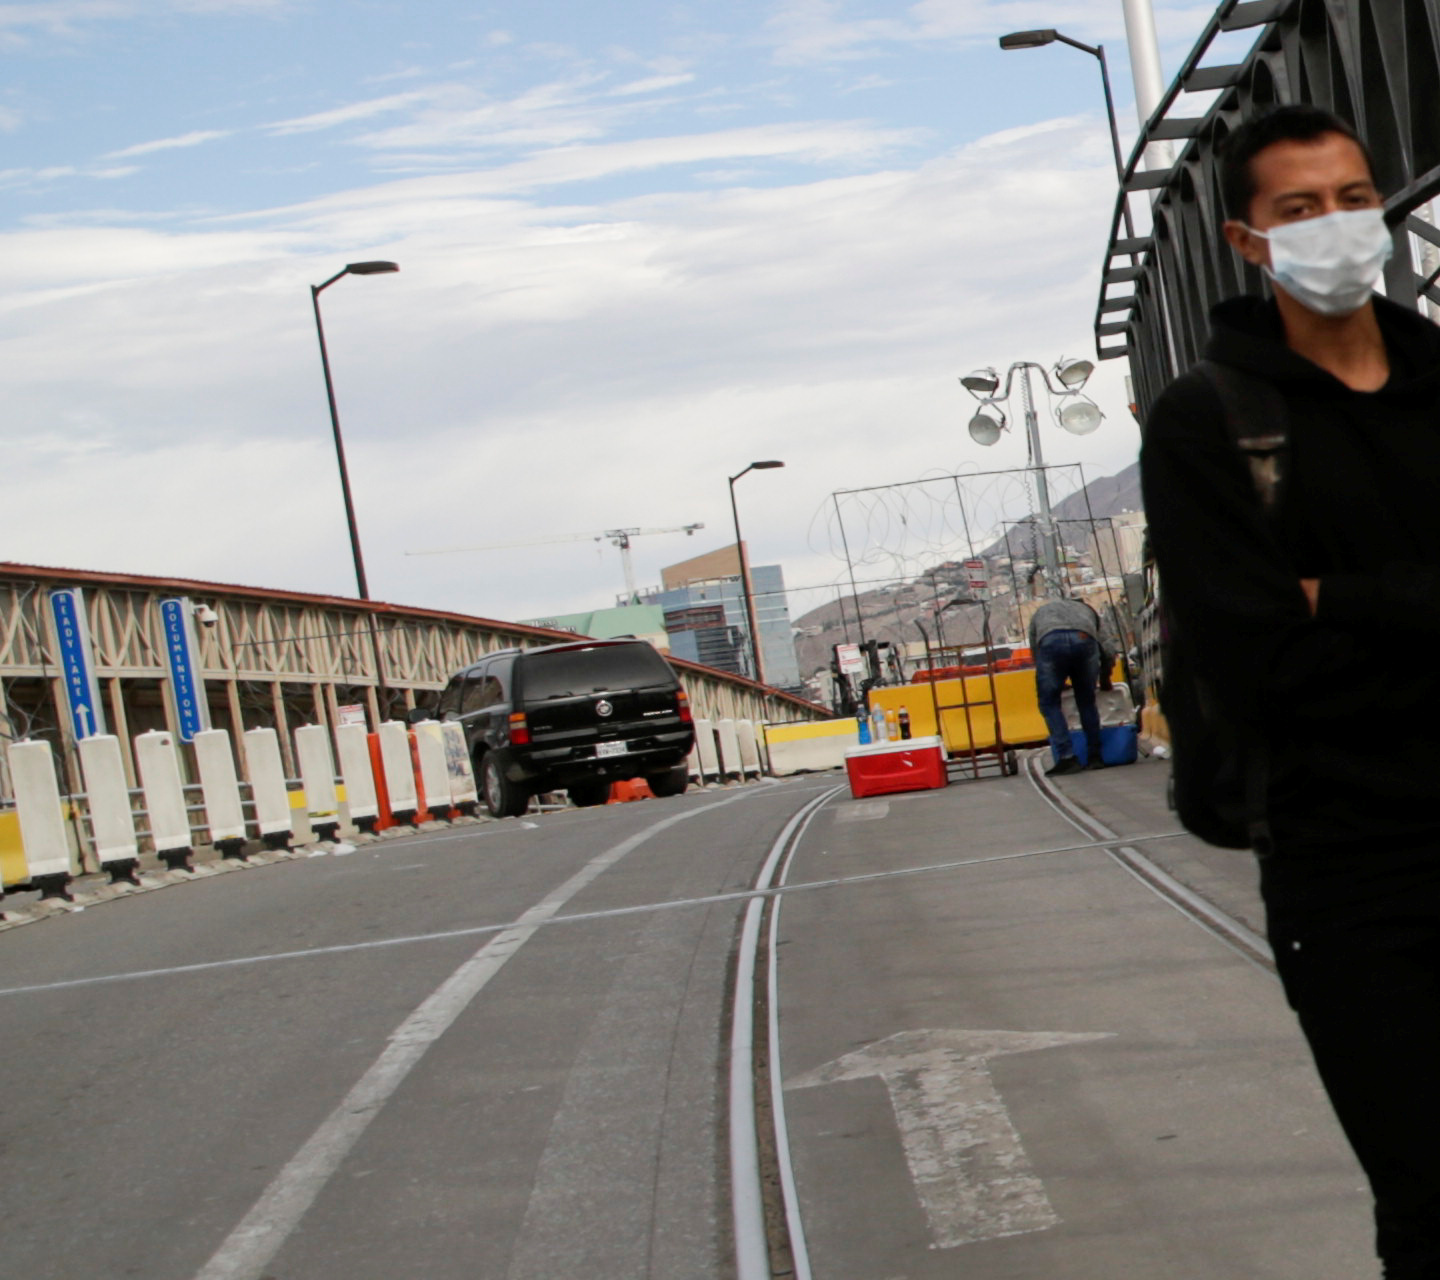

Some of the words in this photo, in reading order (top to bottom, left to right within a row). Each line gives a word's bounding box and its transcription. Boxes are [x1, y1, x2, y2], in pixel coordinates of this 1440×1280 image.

[58, 594, 74, 648] READY
[69, 654, 82, 697] LANE
[167, 602, 188, 694] DOCUMENTS
[182, 699, 195, 738] ONLY
